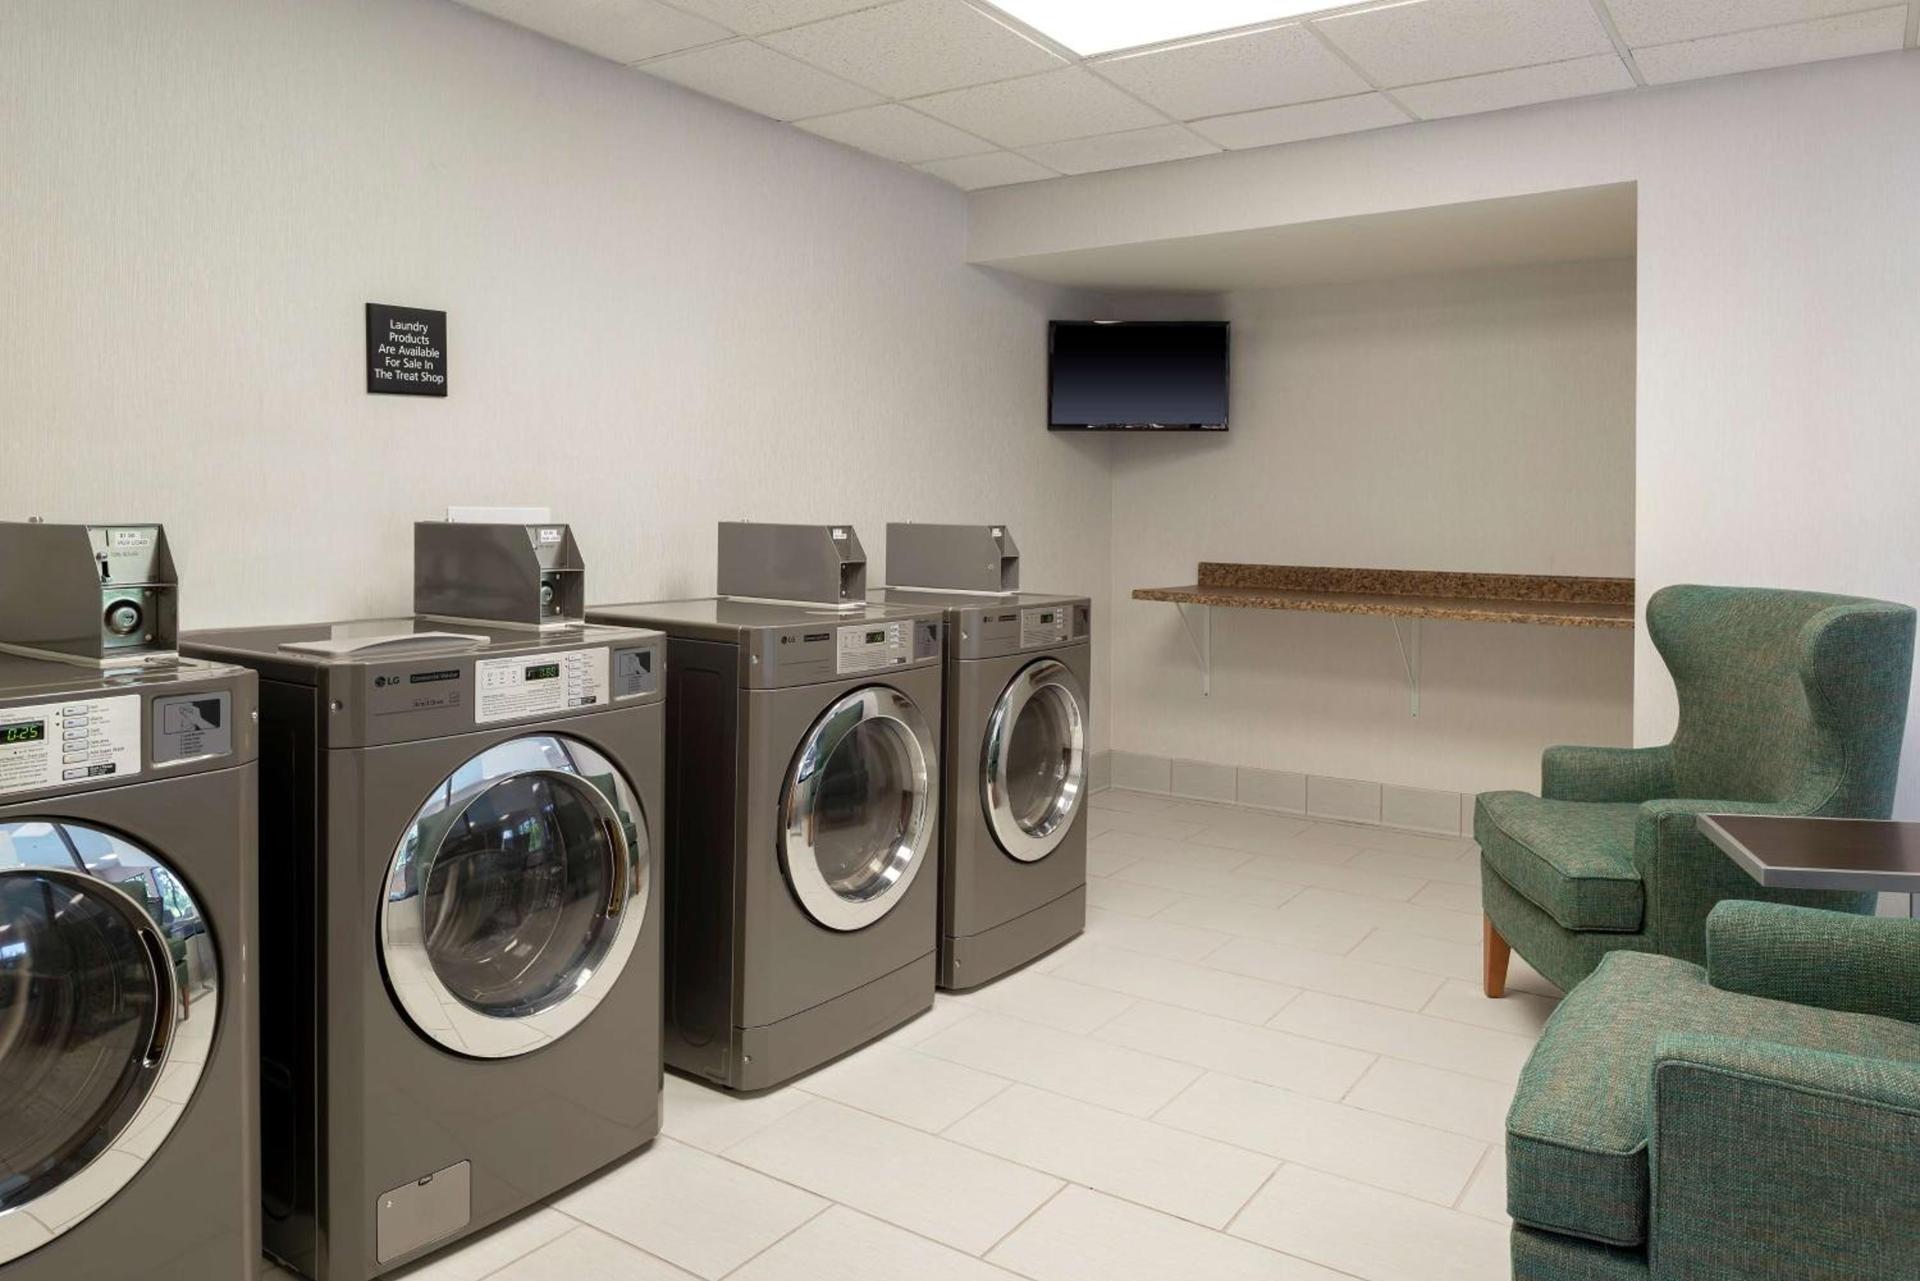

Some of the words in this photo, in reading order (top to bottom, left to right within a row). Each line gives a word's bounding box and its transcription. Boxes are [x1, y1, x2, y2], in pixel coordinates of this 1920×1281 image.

[390, 319, 429, 334] Laundry
[389, 331, 430, 345] Products
[378, 343, 396, 354] Are
[398, 345, 440, 358] Available
[385, 356, 400, 367] For
[403, 357, 423, 369] Sale
[424, 359, 434, 370] In
[374, 367, 393, 380] The
[394, 369, 419, 381] Treat
[420, 371, 444, 384] Shop
